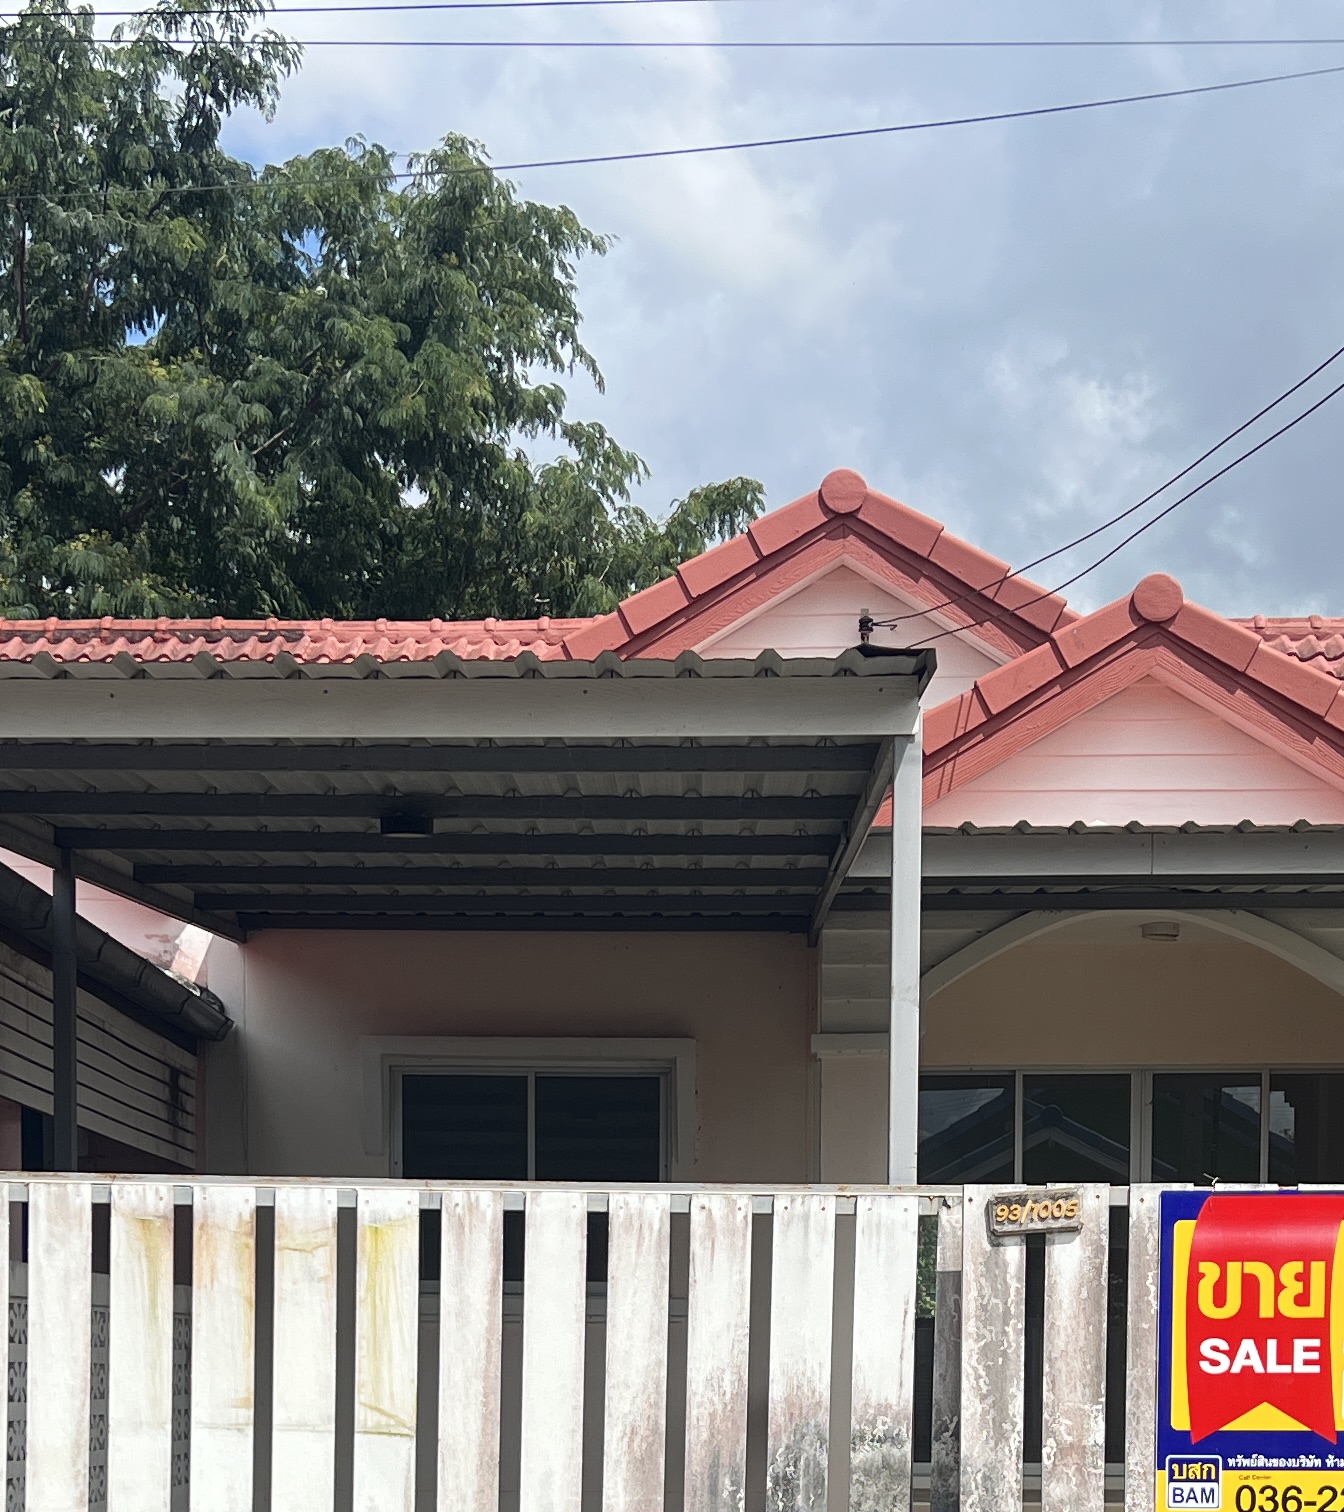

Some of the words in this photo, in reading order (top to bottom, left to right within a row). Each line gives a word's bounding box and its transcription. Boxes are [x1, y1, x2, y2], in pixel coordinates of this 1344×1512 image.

[1198, 1261, 1326, 1319] ขาย
[1198, 1337, 1322, 1375] SALE
[1172, 1461, 1217, 1480] บสก
[1172, 1486, 1216, 1504] BAM
